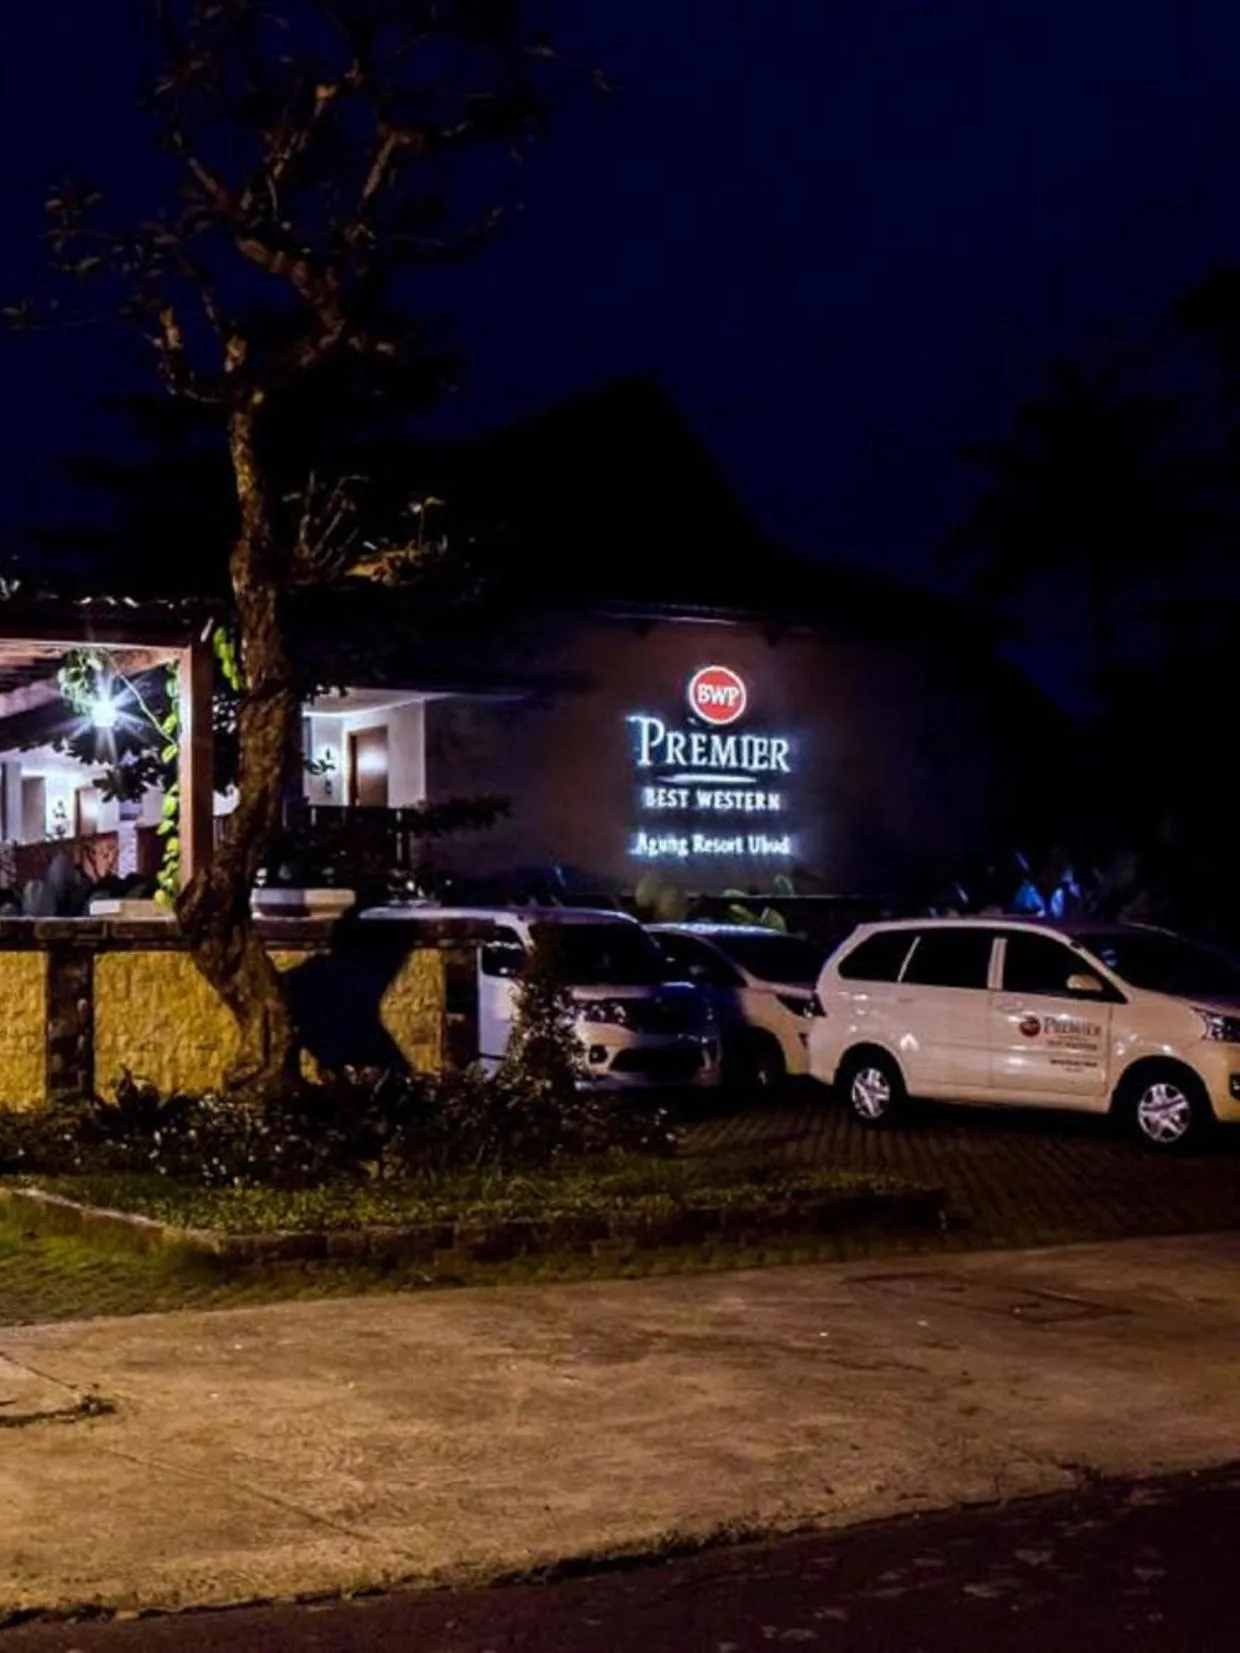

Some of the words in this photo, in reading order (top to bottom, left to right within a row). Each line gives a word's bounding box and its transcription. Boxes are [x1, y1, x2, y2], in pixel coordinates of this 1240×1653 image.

[697, 684, 740, 707] BWP
[626, 715, 791, 772] PREMIER
[643, 787, 690, 808] BEST
[696, 790, 781, 811] WESTERN
[631, 833, 689, 855] Agung
[692, 835, 745, 855] Resort
[748, 837, 792, 855] Ubud
